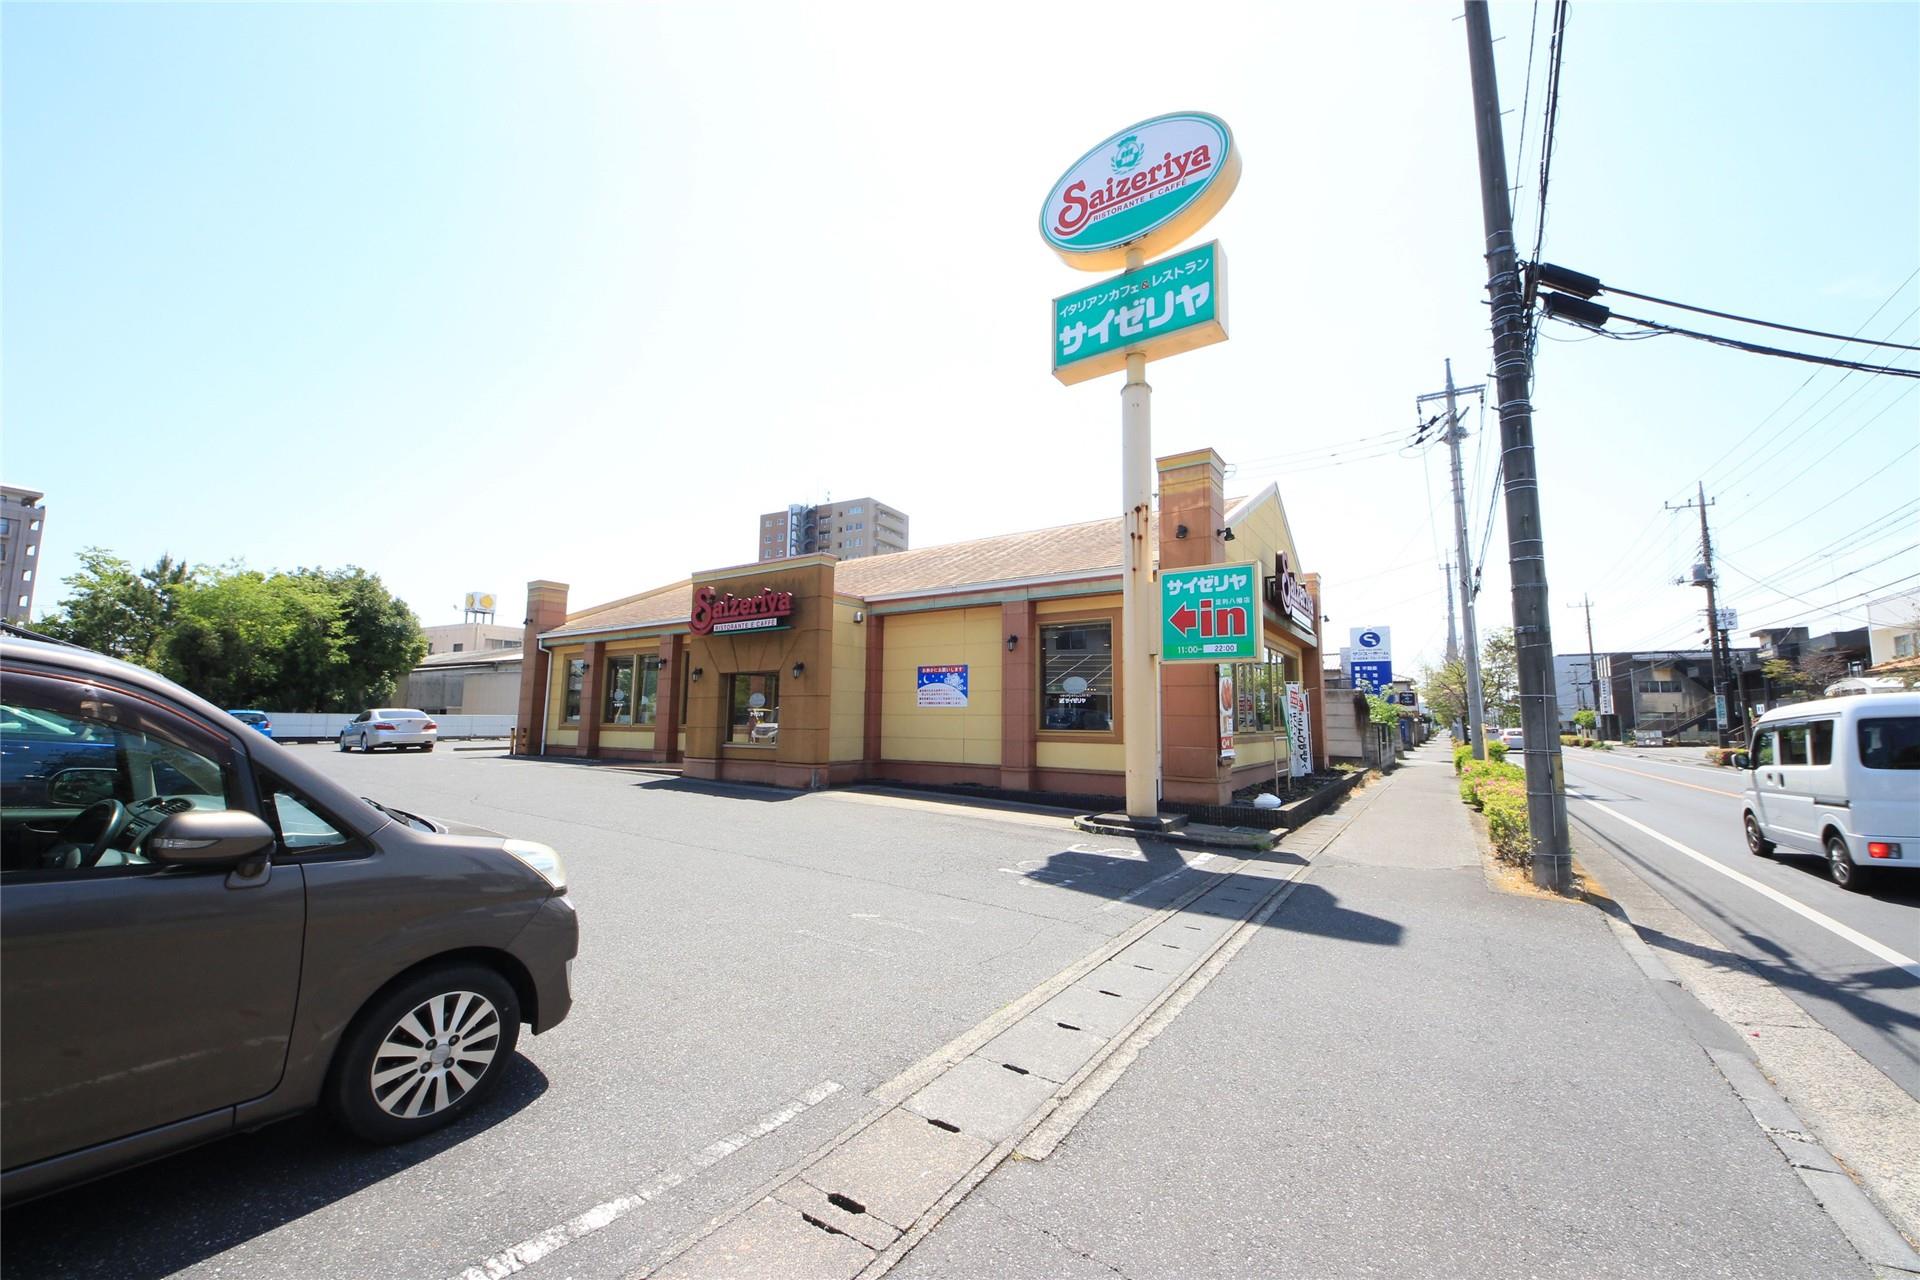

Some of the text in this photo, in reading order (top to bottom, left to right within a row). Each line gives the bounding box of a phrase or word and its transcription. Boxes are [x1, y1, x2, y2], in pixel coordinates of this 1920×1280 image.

[1054, 144, 1211, 235] Saizeriya
[1093, 195, 1145, 222] RISTORANTE
[1149, 190, 1156, 200] E
[1058, 281, 1210, 356] サイゼリヤ
[1167, 574, 1247, 595] サイゼリヤ
[688, 586, 792, 636] Saizeriya
[714, 622, 749, 631] RISTORANTE
[1200, 598, 1247, 638] in
[1214, 644, 1235, 652] 22:00
